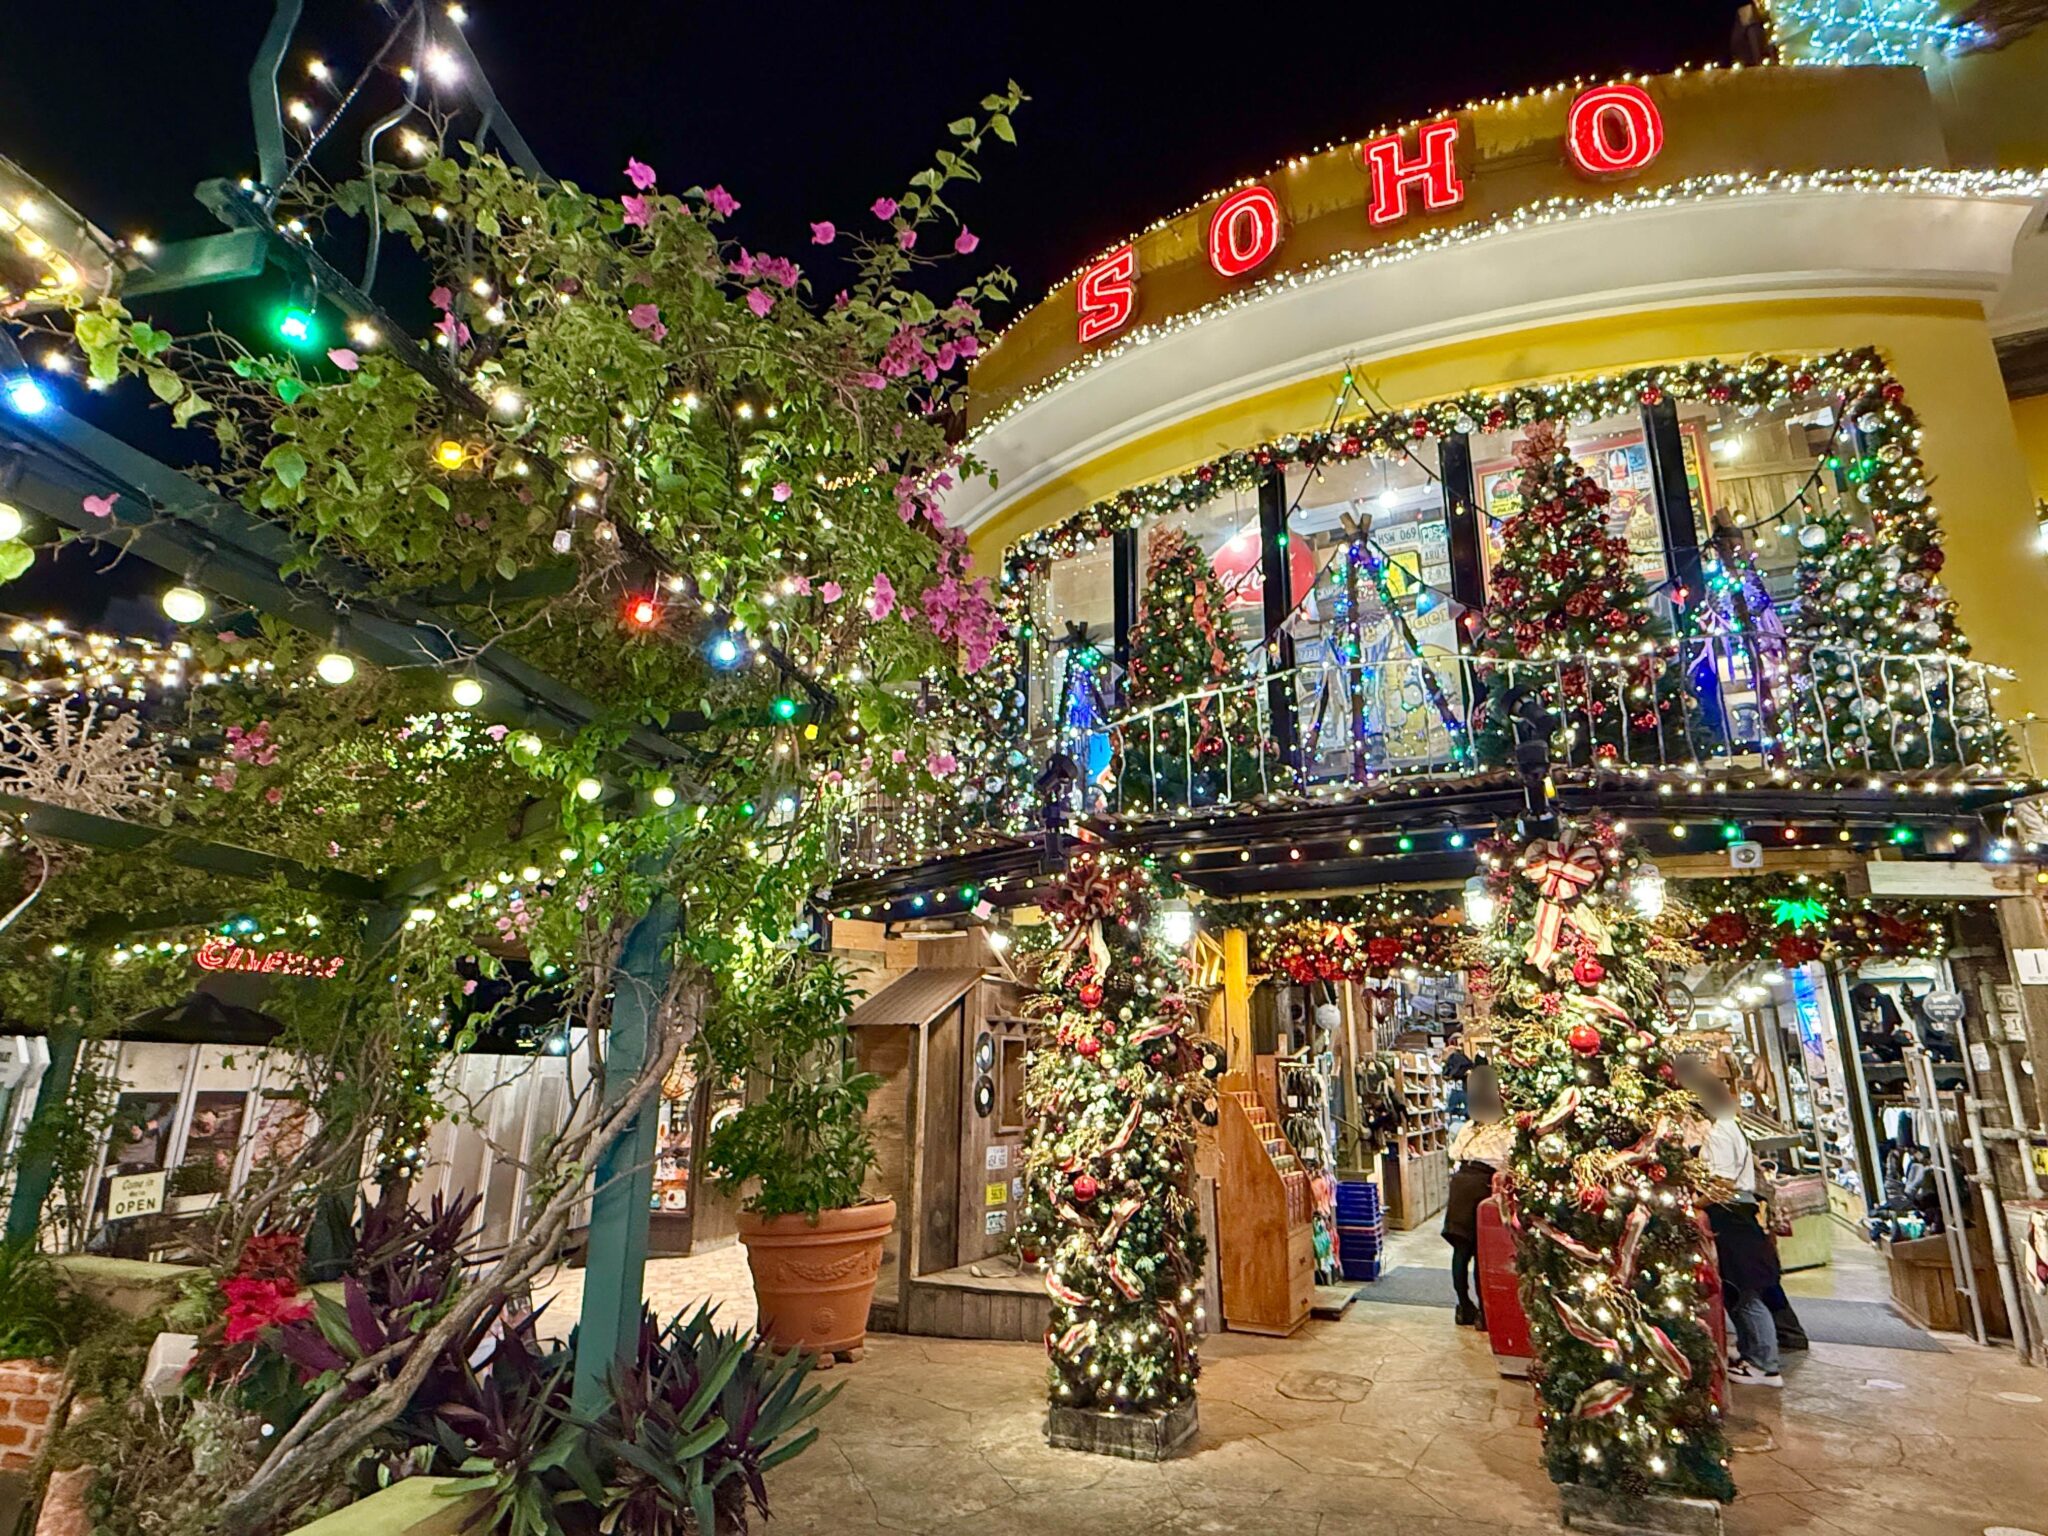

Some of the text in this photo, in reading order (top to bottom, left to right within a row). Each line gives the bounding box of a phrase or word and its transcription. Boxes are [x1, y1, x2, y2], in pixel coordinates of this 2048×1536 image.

[1076, 83, 1664, 345] SOHO
[1399, 527, 1418, 541] 069
[115, 1198, 156, 1215] OPEN
